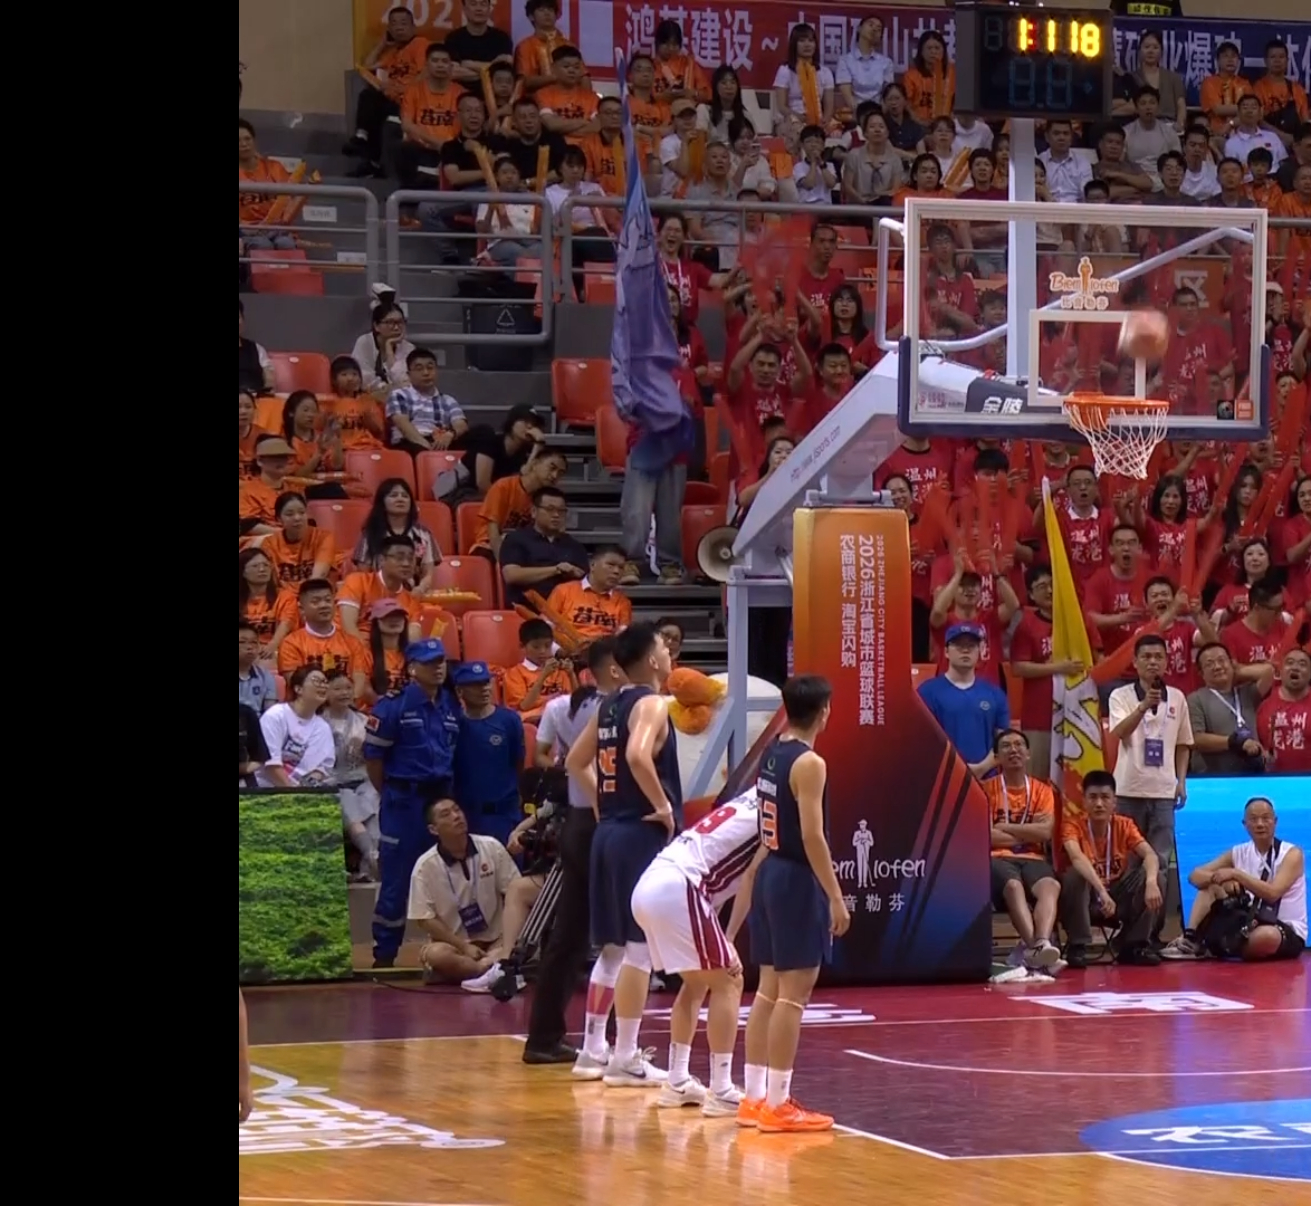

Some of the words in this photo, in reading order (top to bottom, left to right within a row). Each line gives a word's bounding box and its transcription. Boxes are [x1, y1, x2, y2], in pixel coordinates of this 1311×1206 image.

[840, 534, 857, 598] 农商银行
[876, 559, 885, 605] ZHEJIANG
[877, 607, 885, 630] CITY
[1114, 593, 1131, 611] 温
[840, 603, 857, 668] 淘宝闪购
[877, 631, 885, 688] BASKETBALL
[877, 690, 885, 726] LEAGUE
[832, 858, 926, 880] emlofen
[843, 892, 905, 914] 音勒芬
